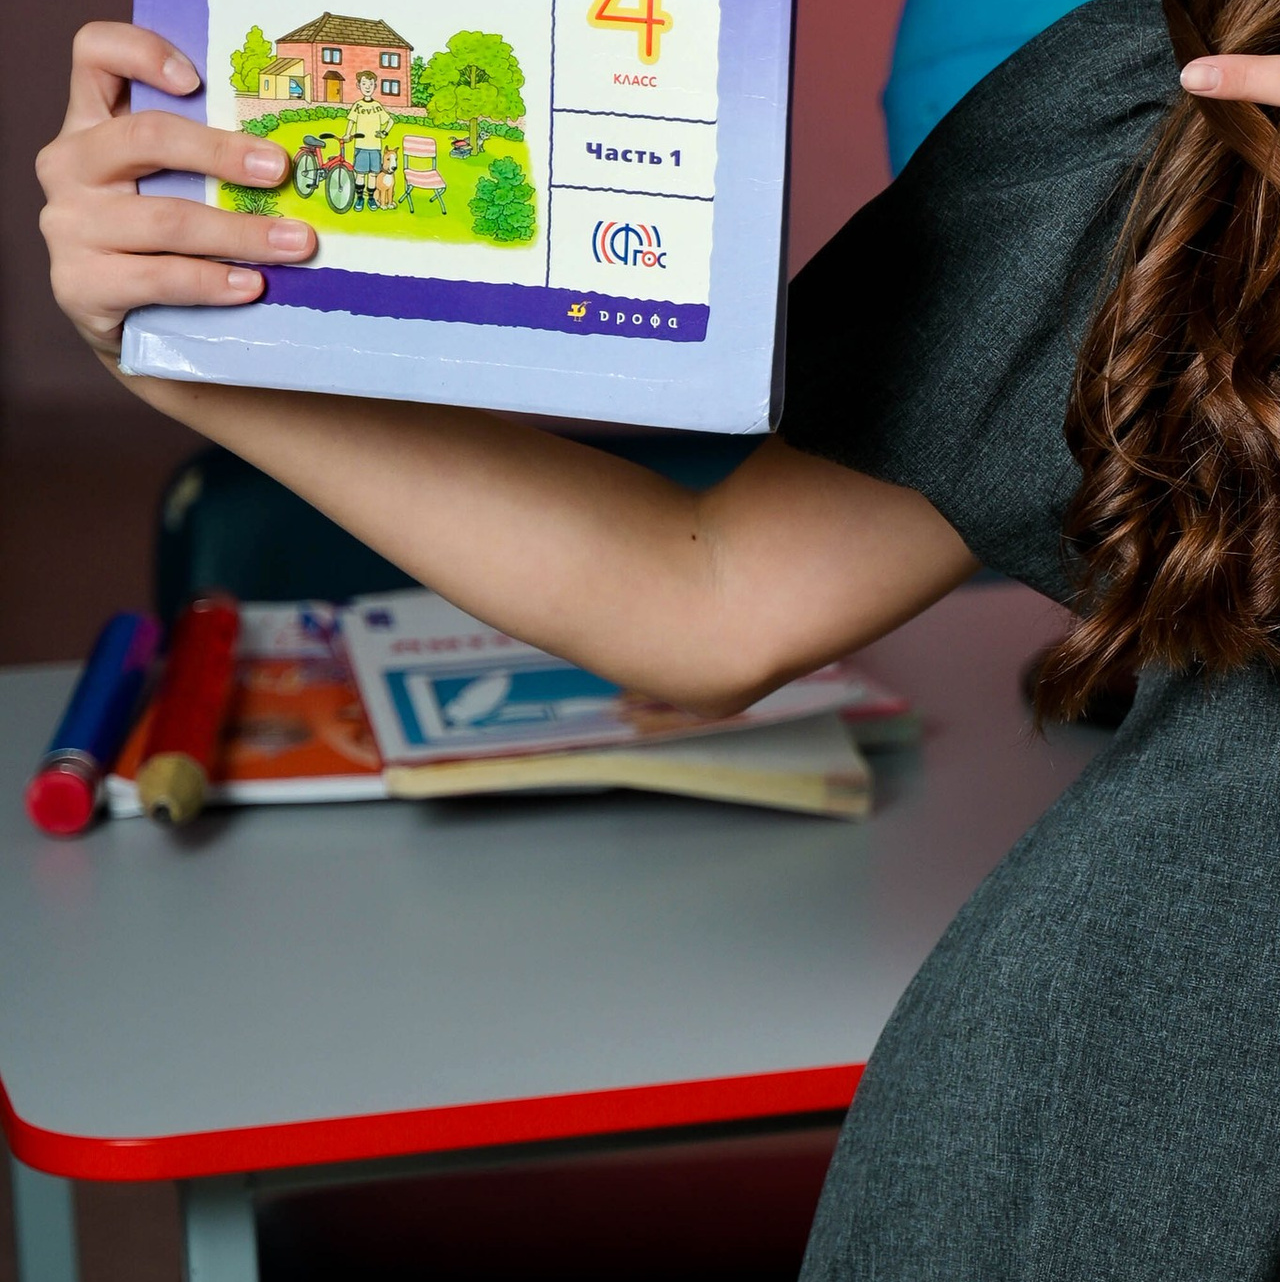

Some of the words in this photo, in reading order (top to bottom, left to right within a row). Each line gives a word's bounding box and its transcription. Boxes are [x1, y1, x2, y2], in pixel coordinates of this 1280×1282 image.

[354, 103, 382, 115] Kevin
[586, 142, 662, 164] Часть
[670, 150, 681, 166] 1
